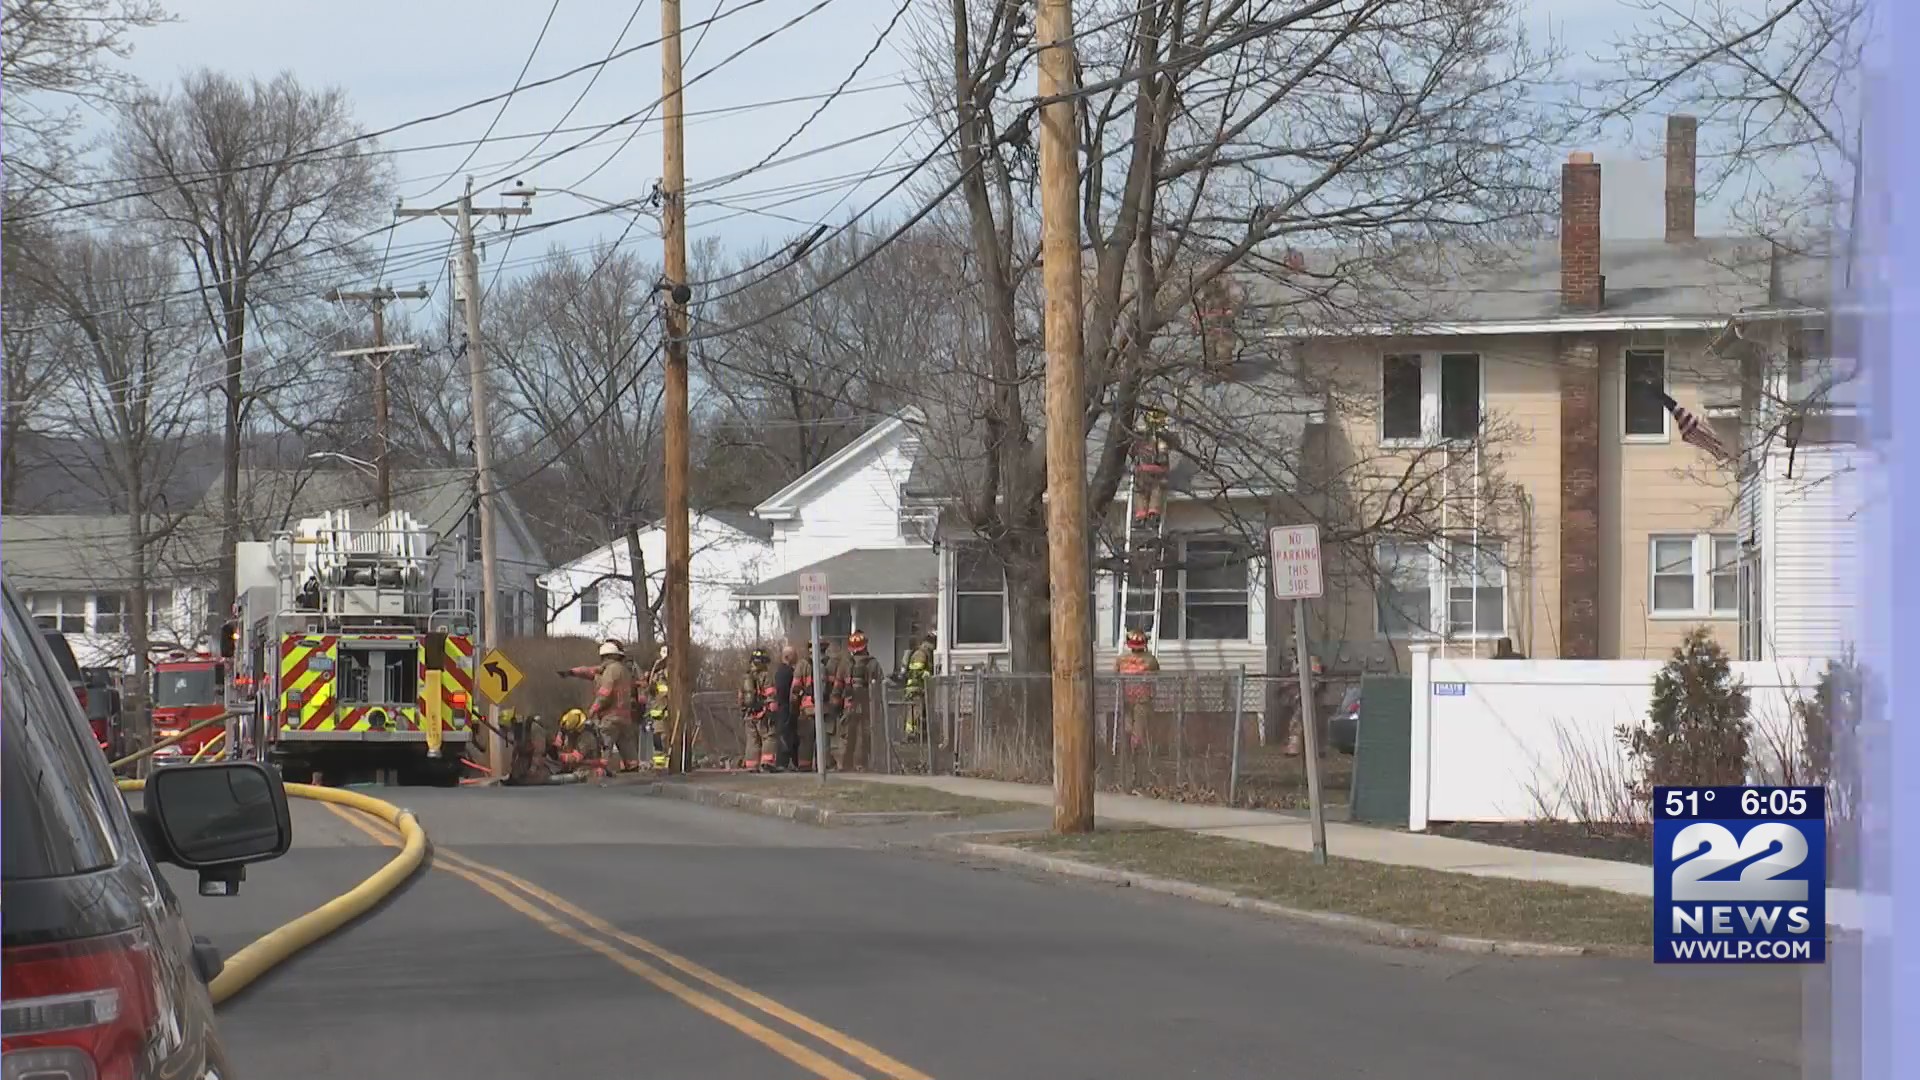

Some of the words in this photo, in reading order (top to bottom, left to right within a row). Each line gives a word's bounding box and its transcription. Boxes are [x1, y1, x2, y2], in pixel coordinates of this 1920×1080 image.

[1288, 533, 1302, 545] NO
[1276, 547, 1317, 562] PARKING
[1288, 565, 1309, 577] THIS
[1288, 579, 1310, 592] SIDE
